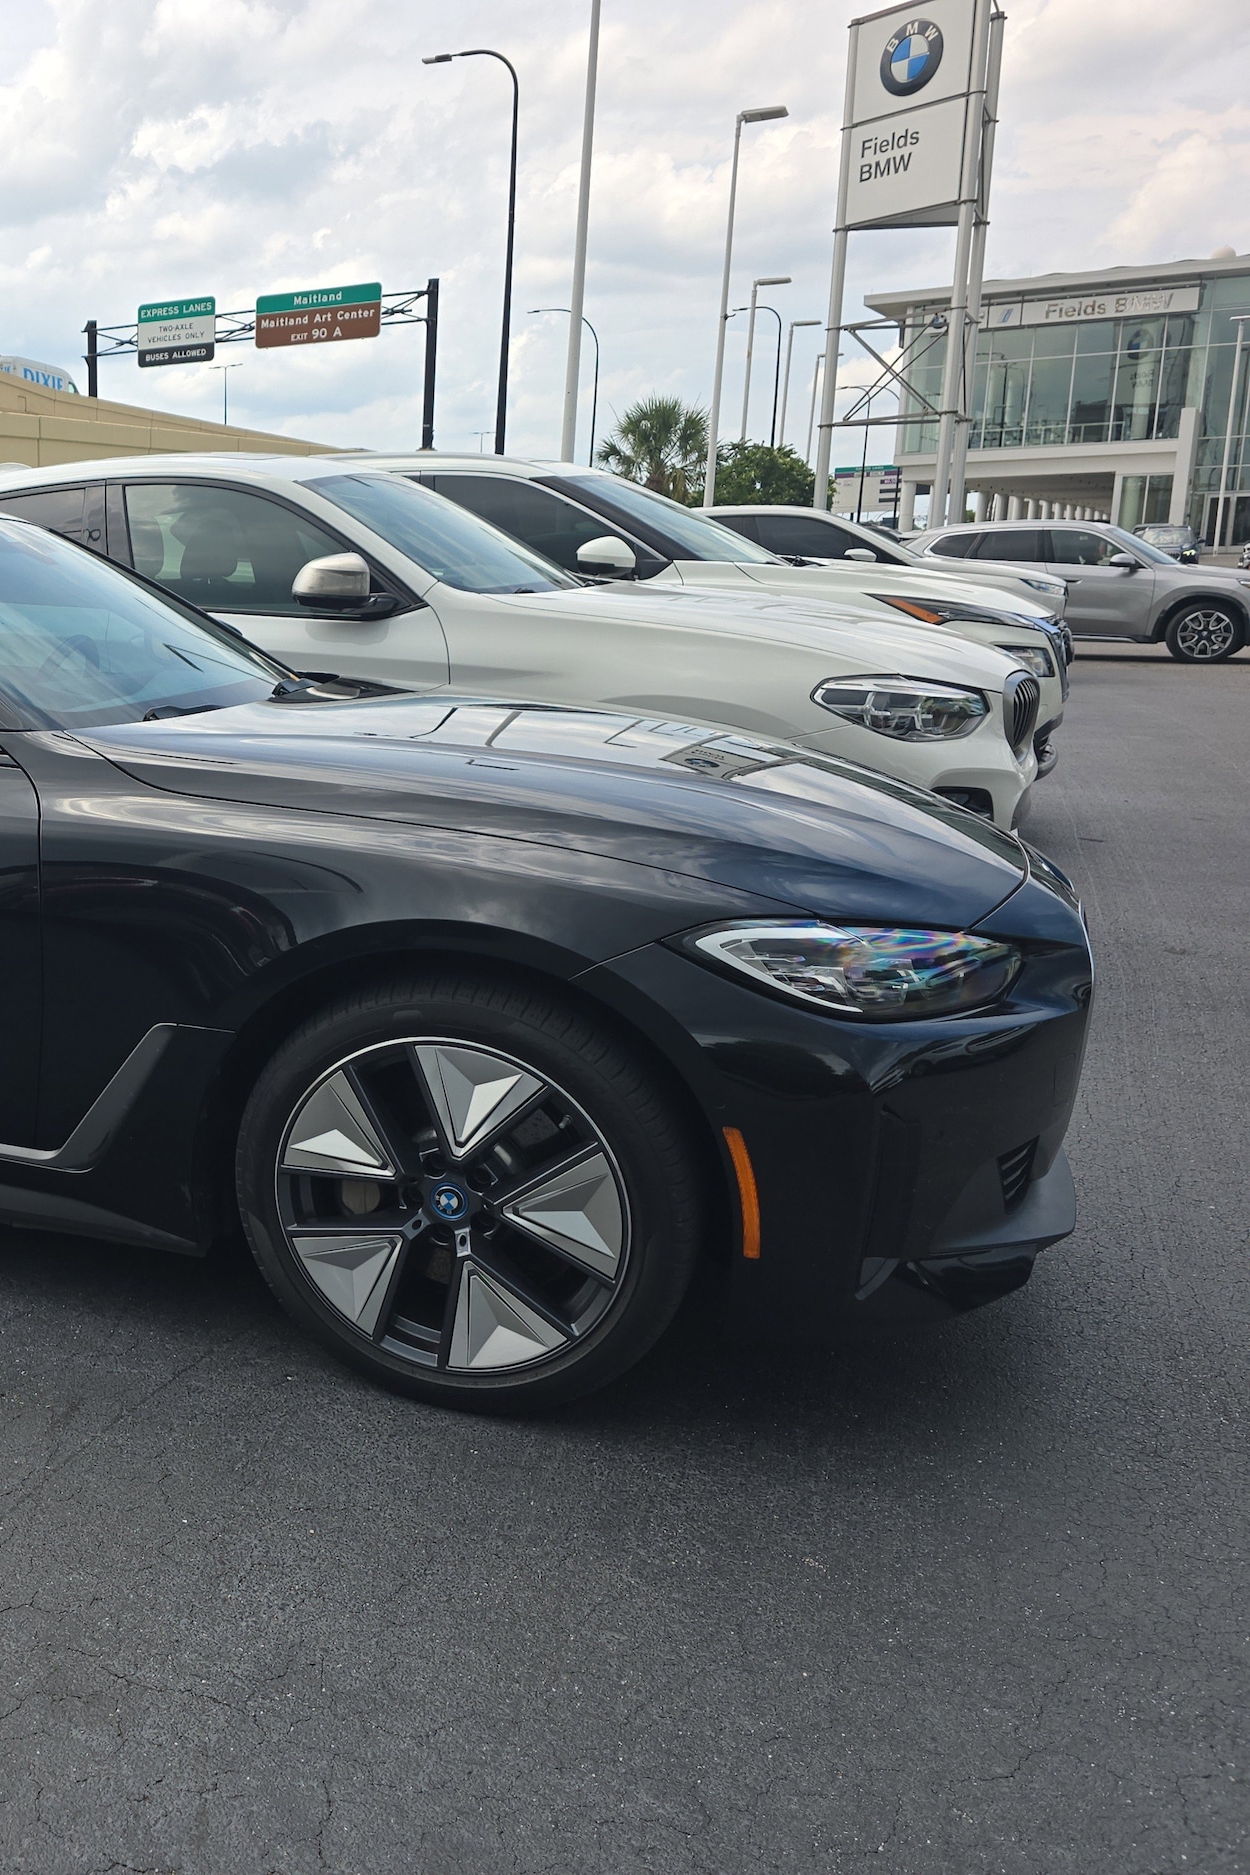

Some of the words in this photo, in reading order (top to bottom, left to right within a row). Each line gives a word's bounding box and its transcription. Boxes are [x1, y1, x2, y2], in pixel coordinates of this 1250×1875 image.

[886, 21, 939, 53] BMW
[861, 128, 919, 158] Fields
[859, 152, 913, 183] BMW
[294, 291, 342, 305] Maitland
[141, 306, 179, 318] EXPRESS
[183, 302, 212, 313] LANES
[1044, 300, 1107, 319] Fields
[261, 315, 308, 329] Maitland
[313, 313, 331, 323] Art
[337, 309, 375, 320] Center
[159, 323, 194, 333] TWO-AXLE
[290, 332, 308, 341] EXIT
[312, 328, 327, 339] 90
[333, 327, 342, 337] A
[147, 333, 182, 343] VEHICLES
[185, 331, 205, 340] ONLY
[145, 352, 169, 362] BUSES
[172, 348, 206, 359] ALLOWED
